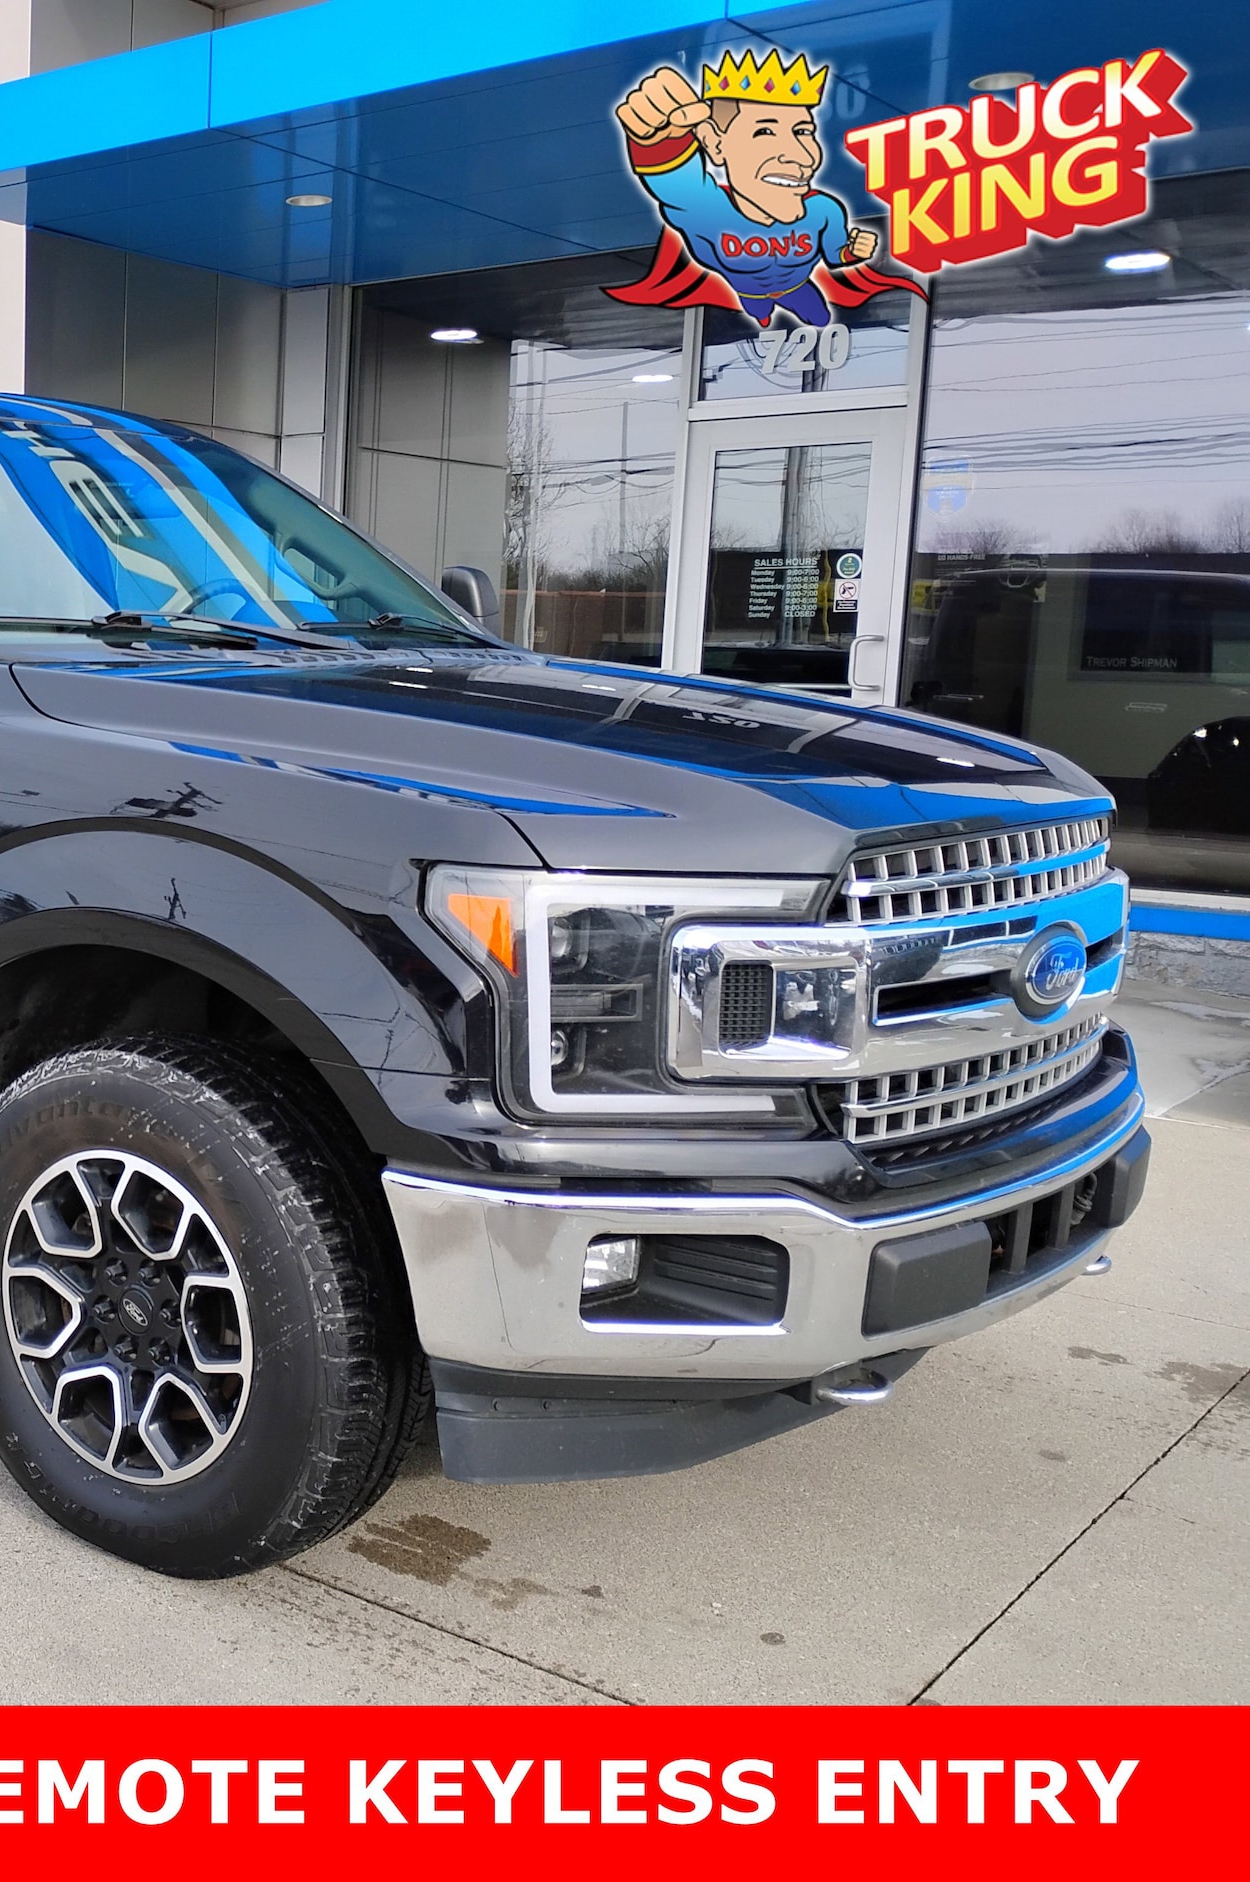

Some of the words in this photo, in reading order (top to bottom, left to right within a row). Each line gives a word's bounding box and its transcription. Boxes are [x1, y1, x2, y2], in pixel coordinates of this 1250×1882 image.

[759, 323, 850, 374] 720
[754, 558, 784, 567] SALES
[785, 557, 818, 566] HOURS
[1045, 951, 1079, 991] Ford
